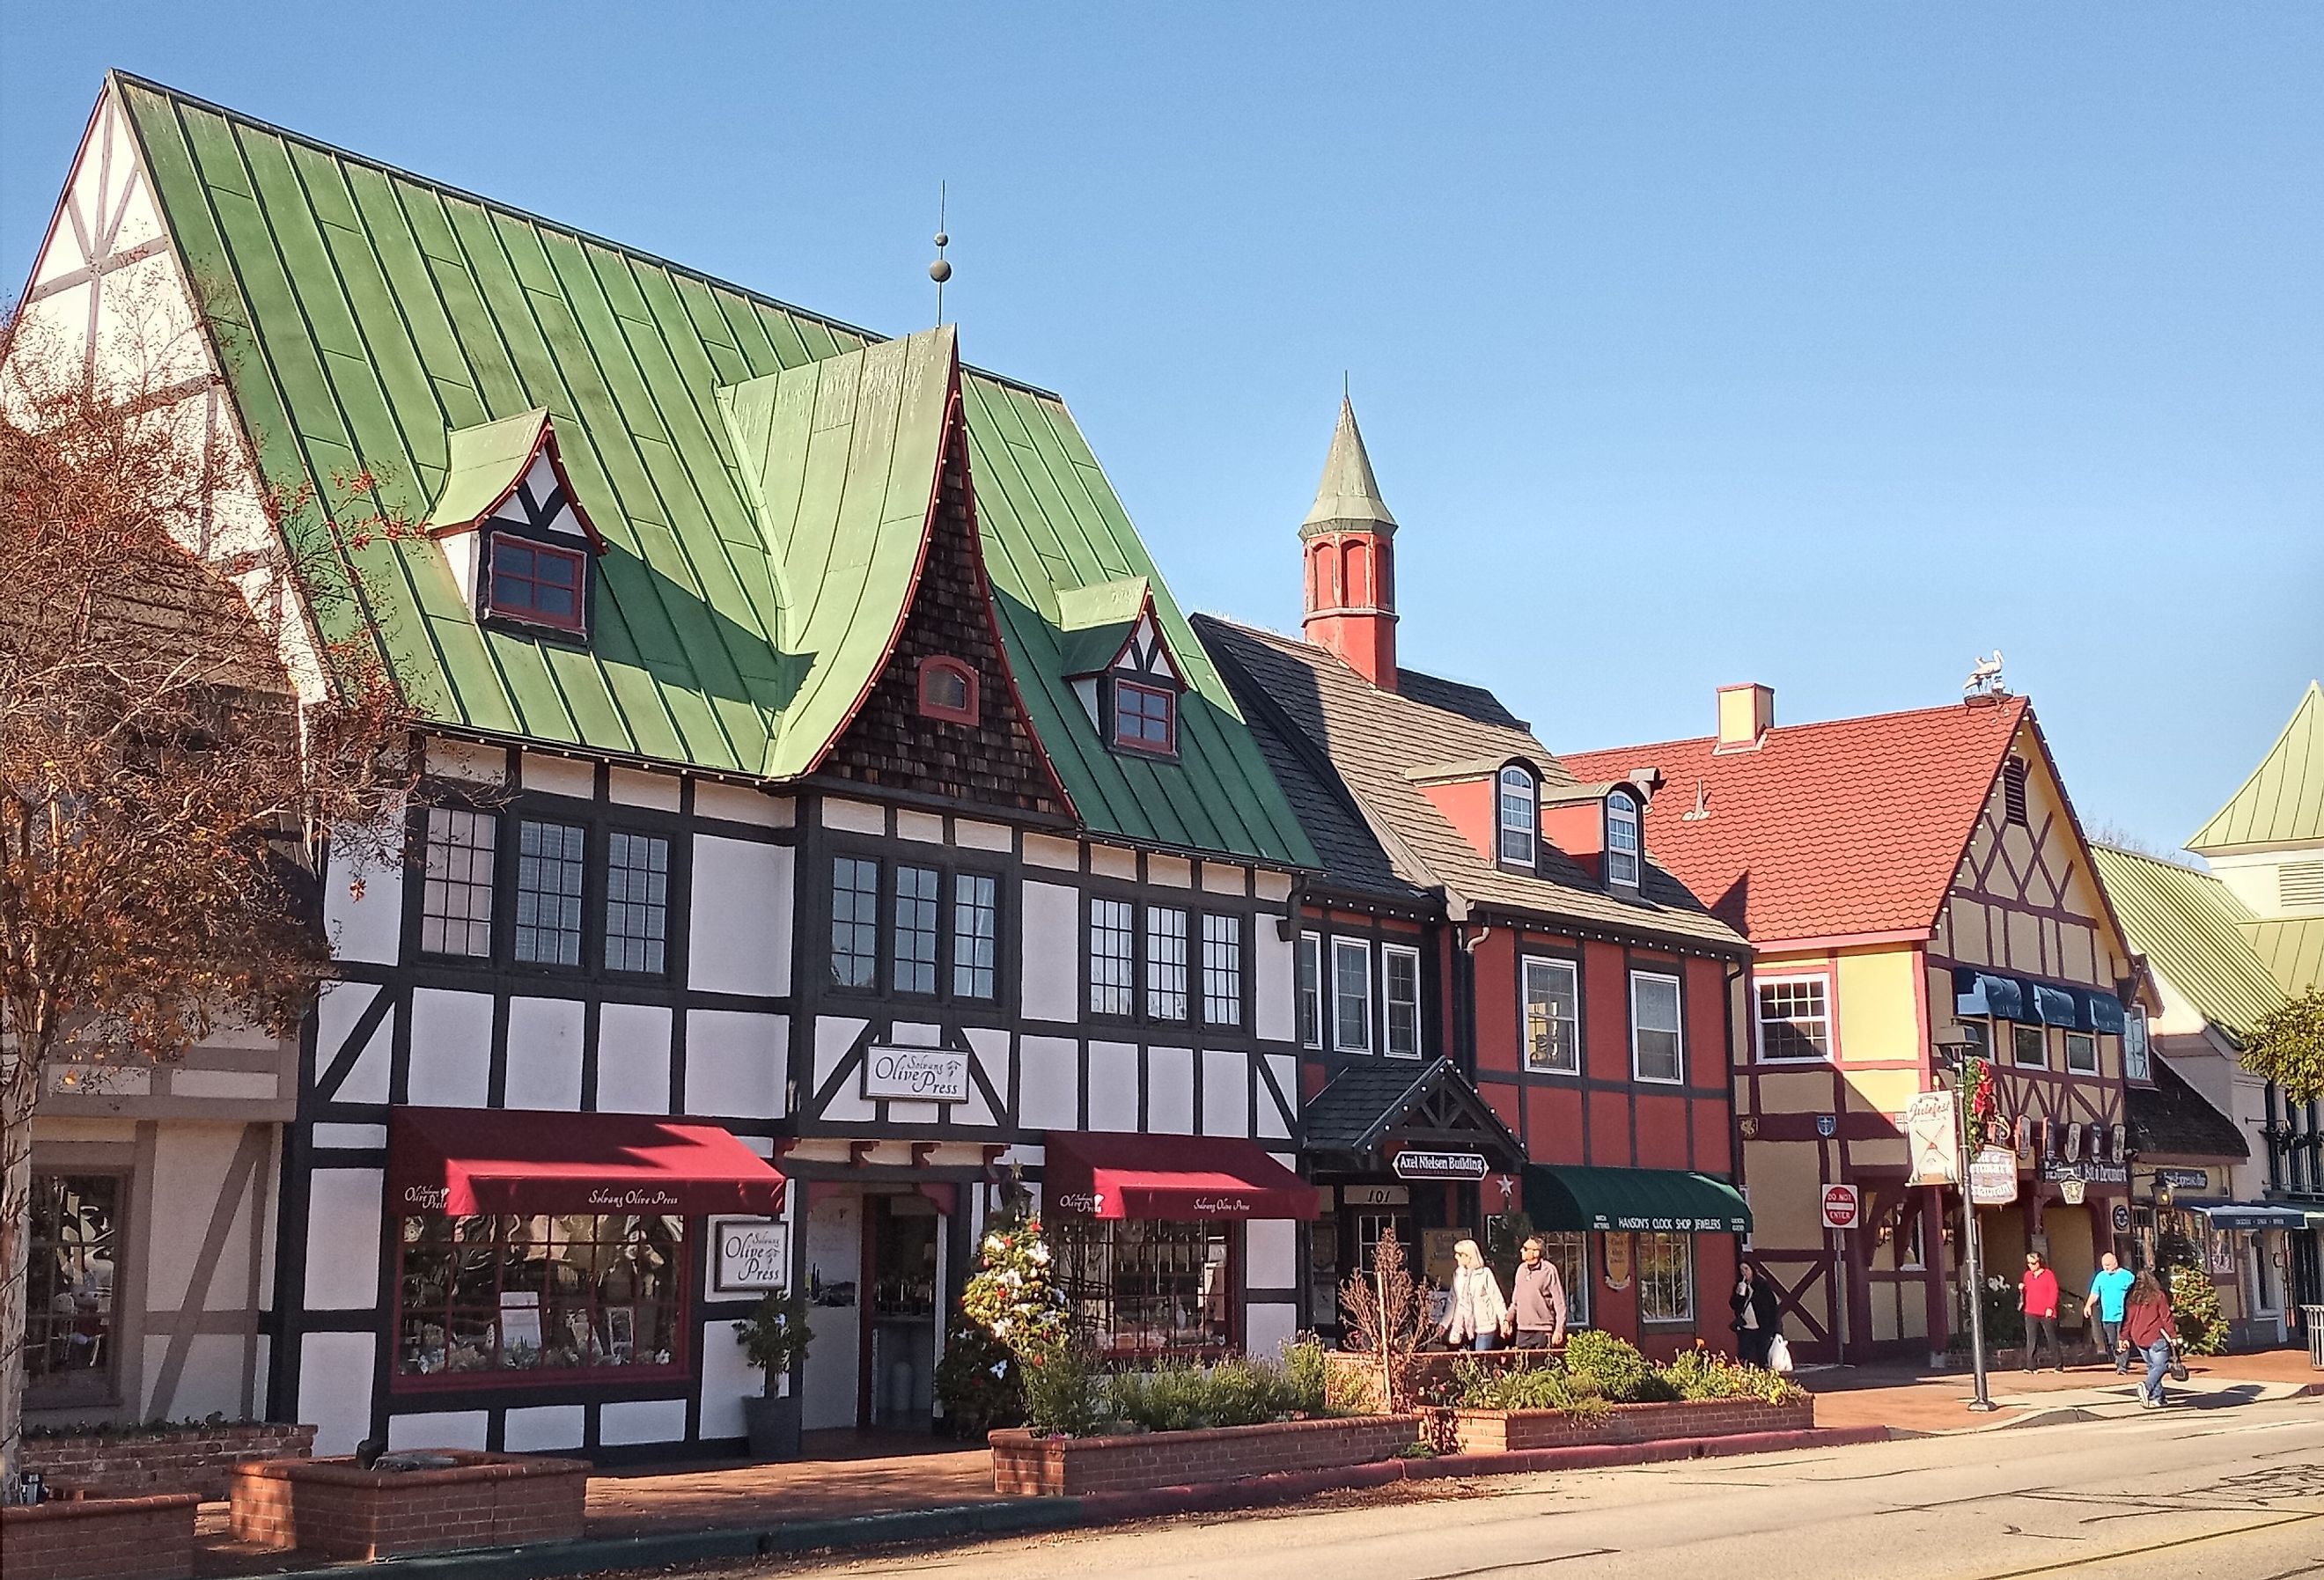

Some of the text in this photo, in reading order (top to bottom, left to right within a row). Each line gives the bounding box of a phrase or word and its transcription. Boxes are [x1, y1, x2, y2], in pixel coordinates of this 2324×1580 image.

[875, 1055, 920, 1081] Olive
[912, 1071, 958, 1095] Press
[1400, 1155, 1418, 1169] Axel
[1419, 1156, 1448, 1170] Nielsen
[1448, 1157, 1483, 1174] Building
[588, 1187, 678, 1209] Solvang Olive Press
[1367, 1189, 1391, 1203] 101
[1828, 1193, 1837, 1202] DO
[1618, 1216, 1650, 1230] HANSON'S
[1651, 1217, 1673, 1230] CLOCK
[1675, 1217, 1692, 1230] SHOP
[1694, 1218, 1722, 1231] JEWELERS
[1830, 1210, 1850, 1219] ENTER
[725, 1232, 764, 1259] Olive
[738, 1258, 779, 1281] Press
